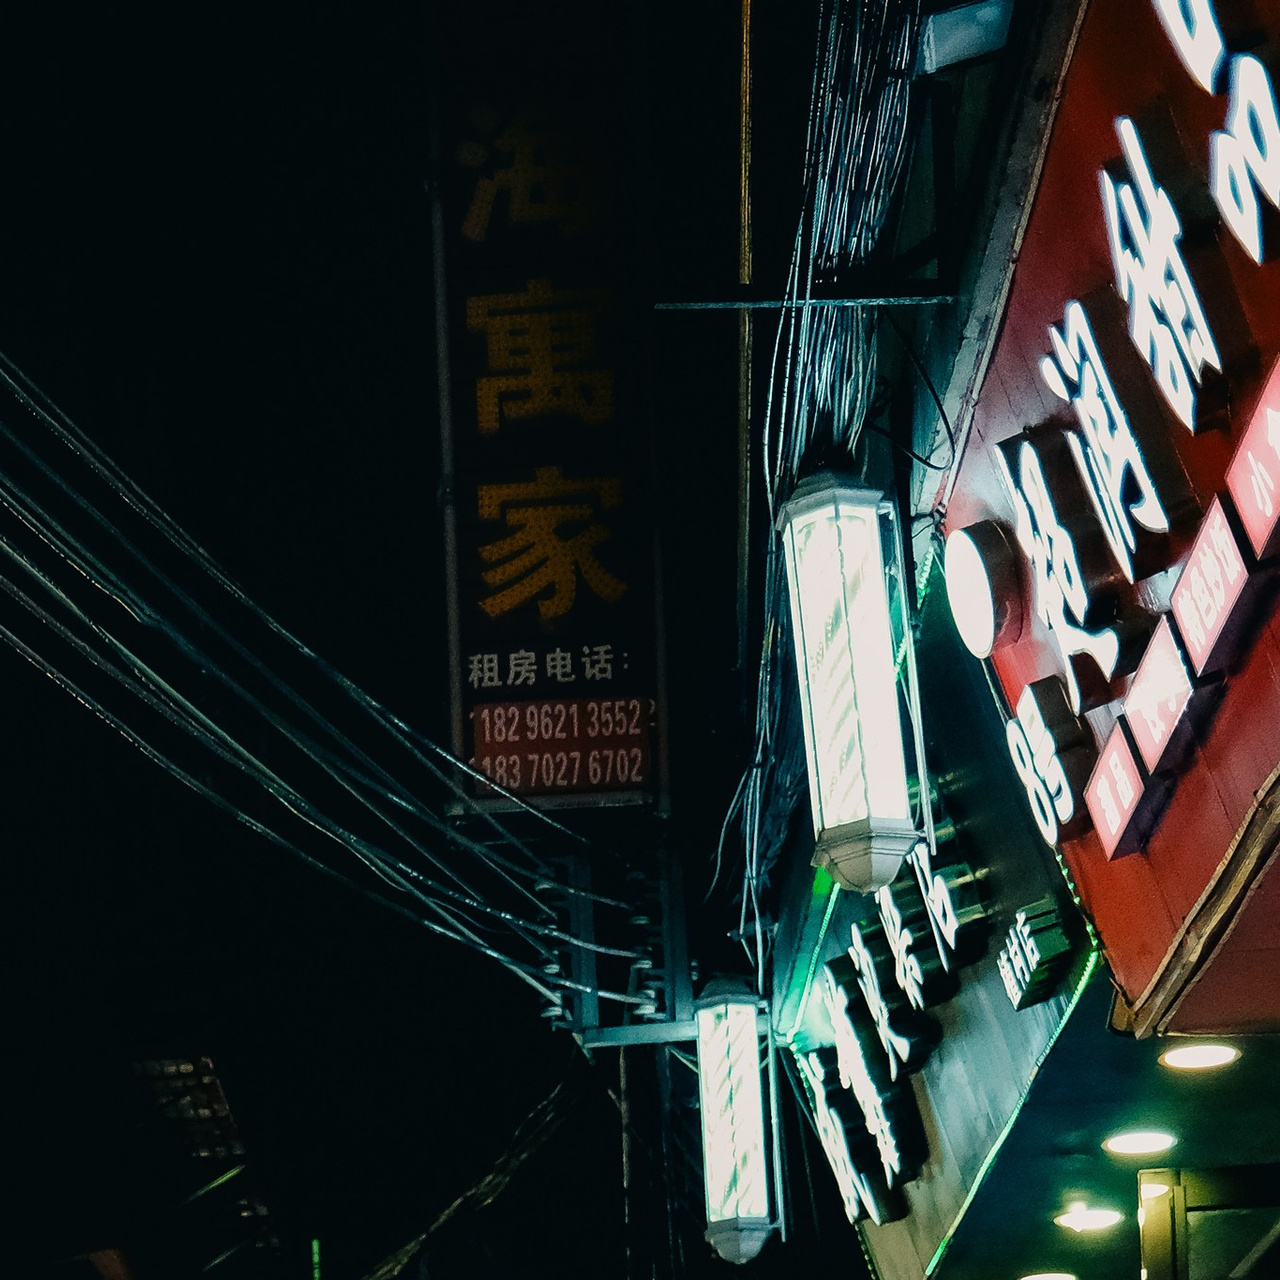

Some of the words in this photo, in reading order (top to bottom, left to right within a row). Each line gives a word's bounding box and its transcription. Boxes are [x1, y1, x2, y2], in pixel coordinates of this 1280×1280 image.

[481, 706, 521, 744] 182
[526, 703, 579, 741] 9621
[587, 699, 641, 738] 3552
[527, 751, 581, 788] 7027
[589, 748, 643, 786] 6702
